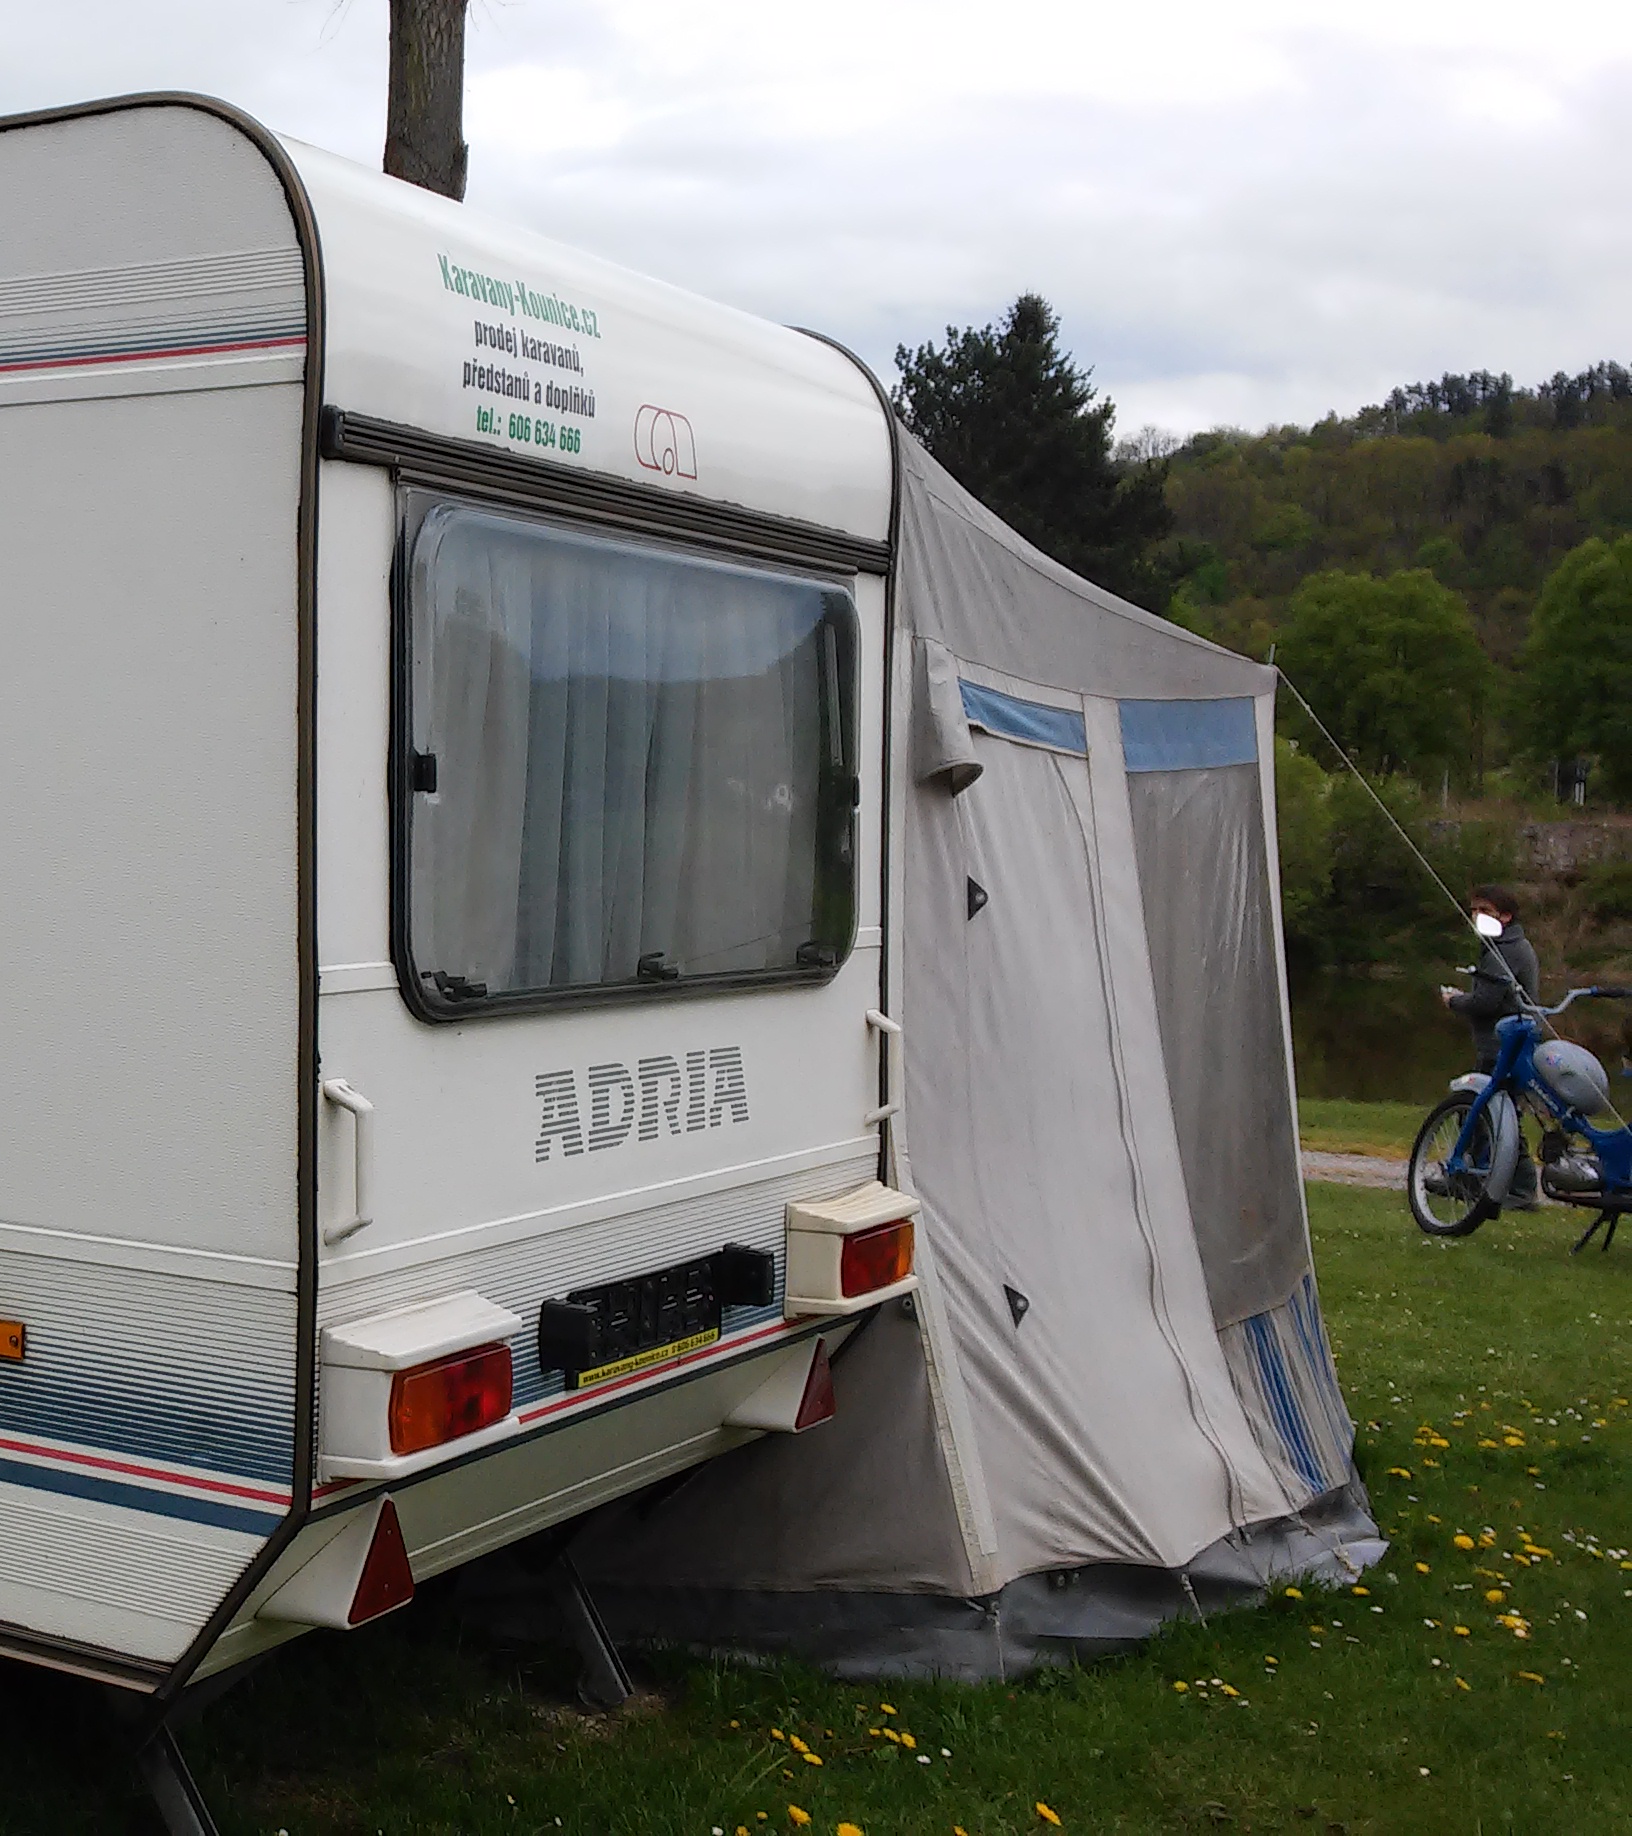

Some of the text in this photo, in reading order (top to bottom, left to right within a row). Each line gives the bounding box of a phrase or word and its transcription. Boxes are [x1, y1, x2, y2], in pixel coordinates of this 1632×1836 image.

[437, 253, 601, 339] Karavany-Kounice.cz
[474, 320, 584, 377] prodej karavanů,
[462, 357, 596, 418] předstanů a doplňků
[476, 405, 581, 454] tel.: 606 634 666
[535, 1046, 750, 1163] ADRIA
